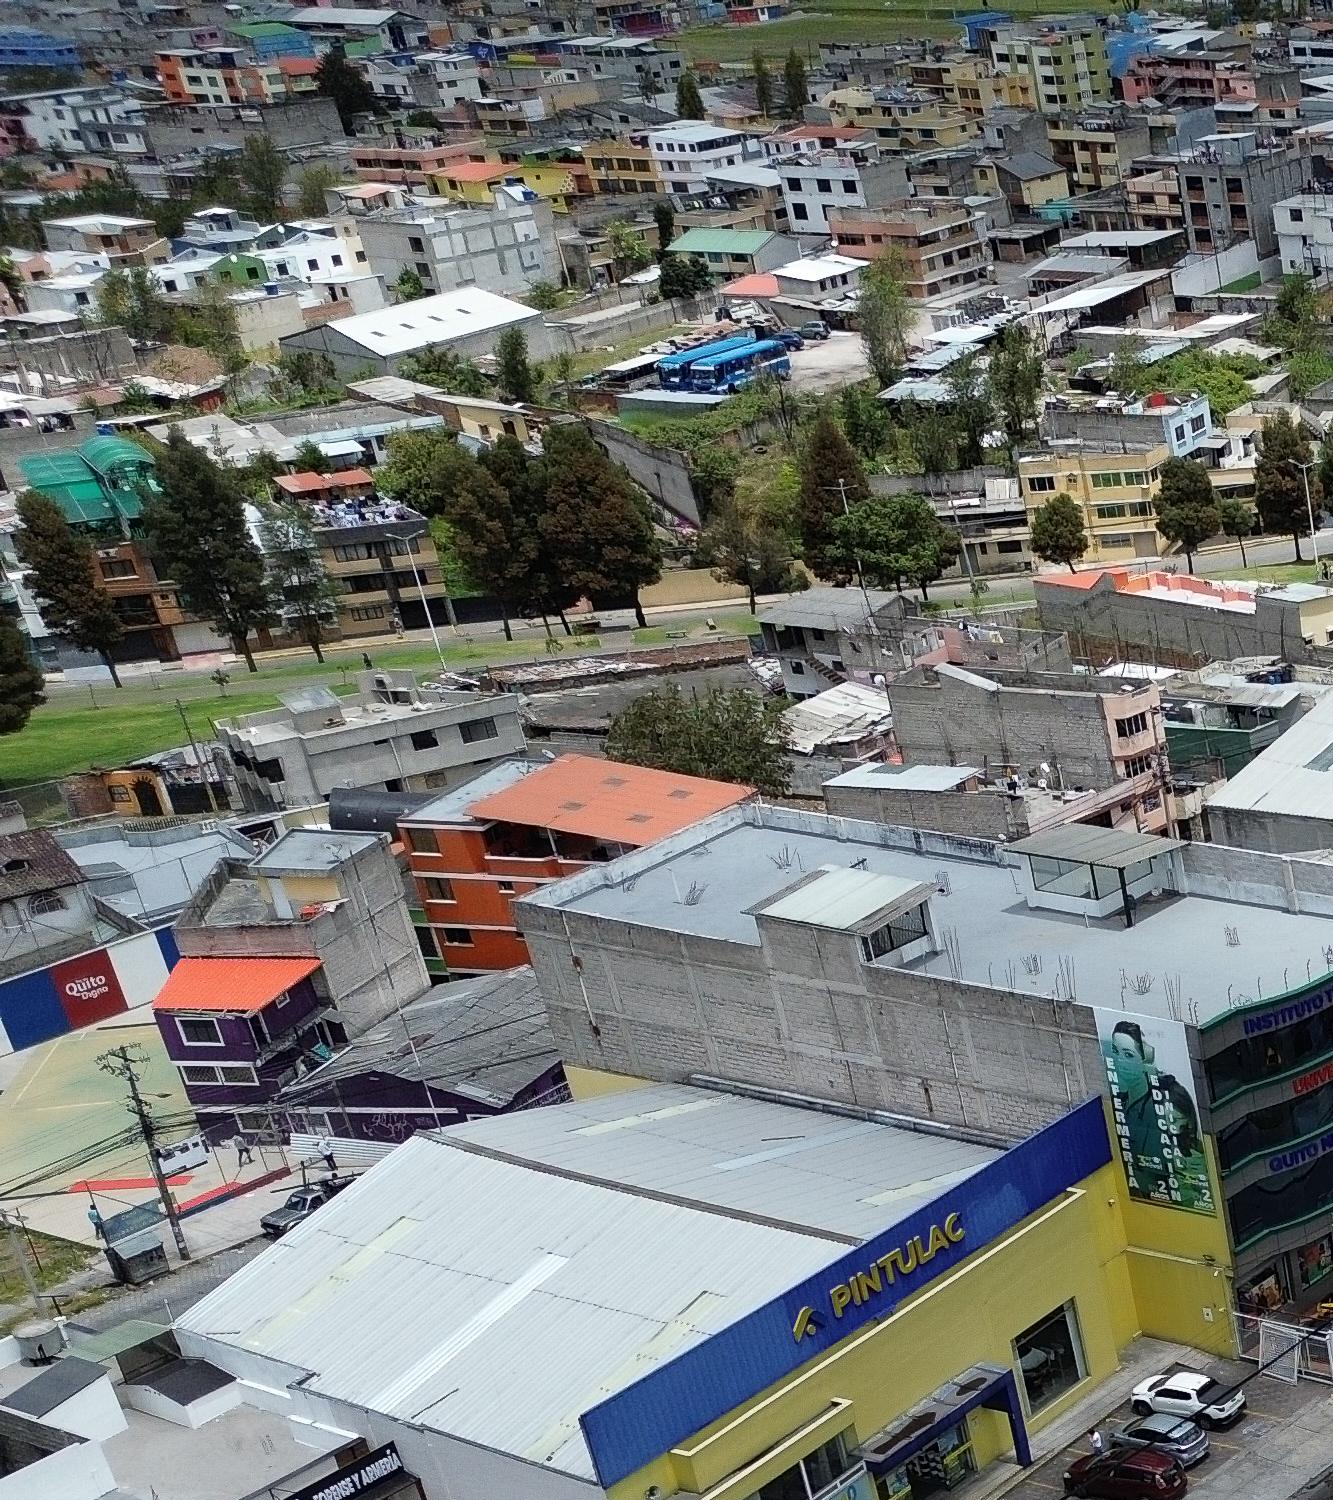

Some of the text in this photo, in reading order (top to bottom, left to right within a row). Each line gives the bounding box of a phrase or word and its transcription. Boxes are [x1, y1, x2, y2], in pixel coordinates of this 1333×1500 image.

[65, 975, 106, 997] Quito
[1157, 1180, 1168, 1193] 2
[1201, 1189, 1212, 1202] 2
[829, 1211, 966, 1319] PINTULAC
[350, 1473, 362, 1490] Y
[360, 1449, 403, 1487] ARMERÍA
